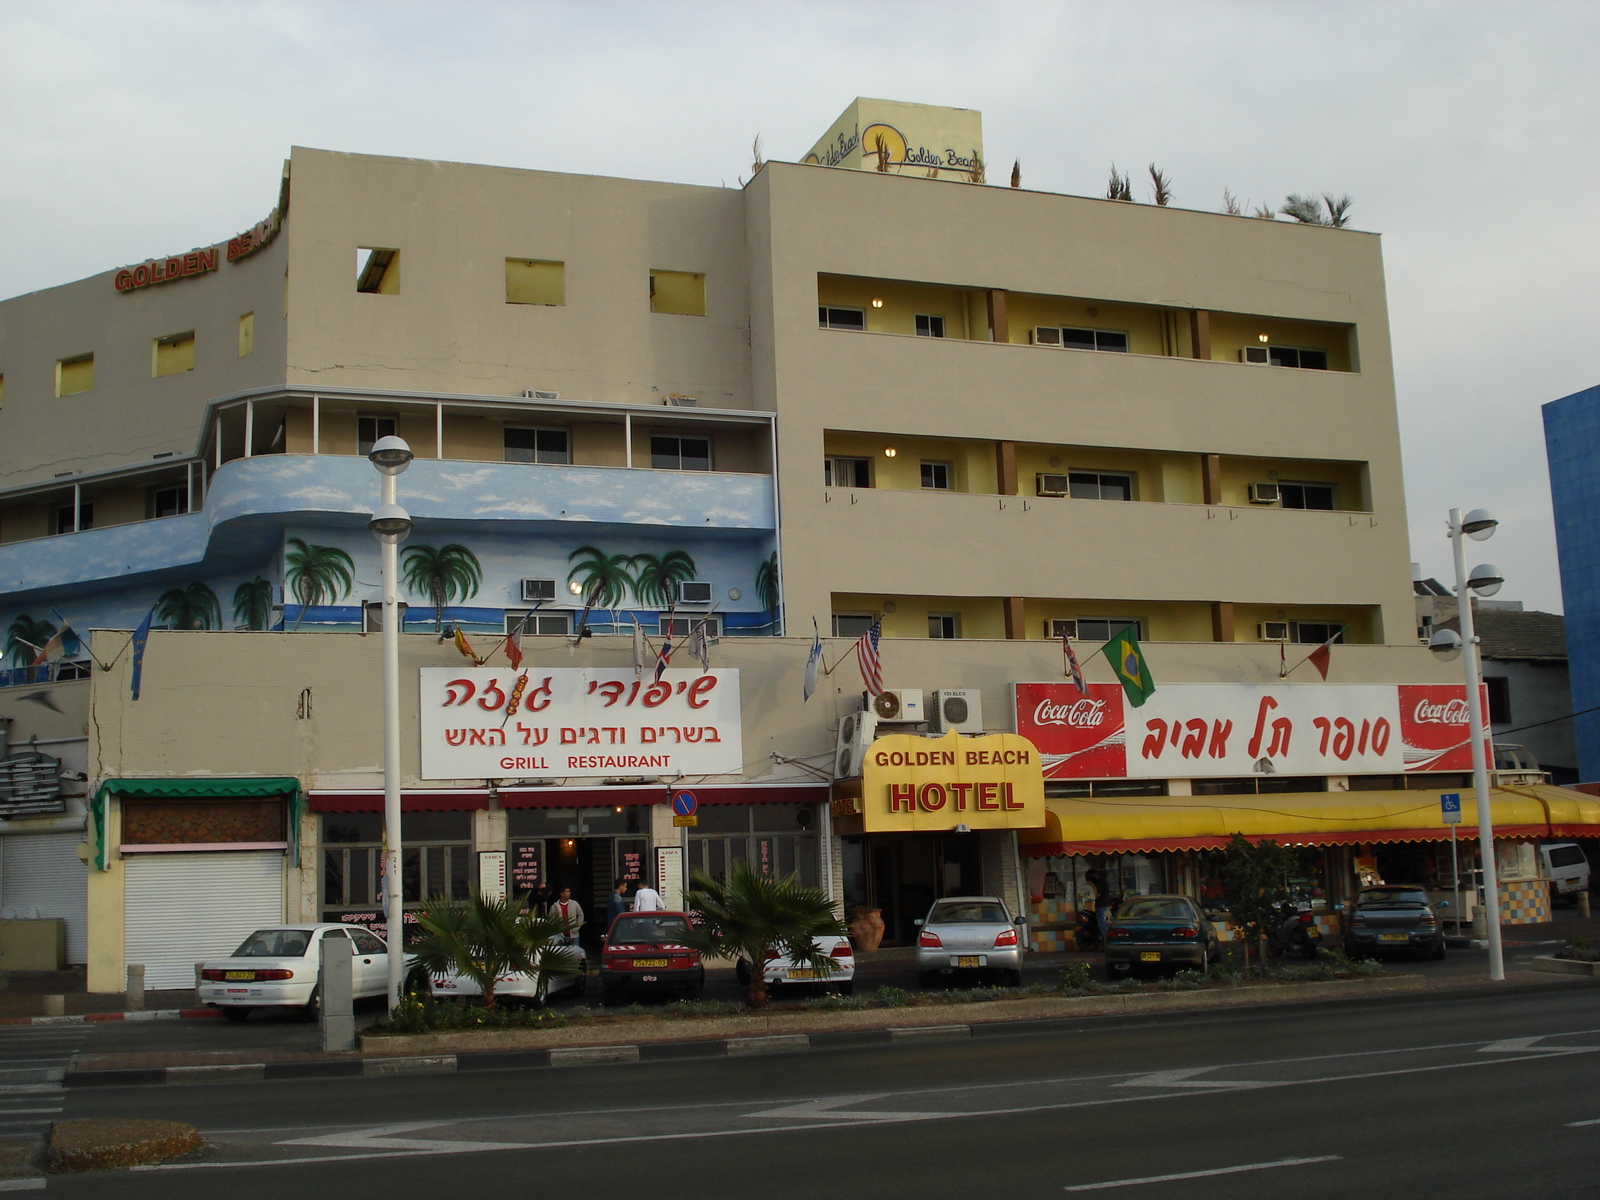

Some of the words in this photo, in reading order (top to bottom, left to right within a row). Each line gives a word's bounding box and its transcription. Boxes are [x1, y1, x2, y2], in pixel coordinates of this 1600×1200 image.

[906, 146, 944, 166] Golden
[114, 248, 217, 292] GOLDEN
[587, 675, 718, 709] שיפודי
[1033, 698, 1107, 727] Coca-Cola
[444, 727, 507, 747] האש
[515, 721, 549, 747] על
[559, 726, 627, 745] ודגים
[640, 726, 722, 744] בשרים
[1141, 717, 1233, 760] אביב
[1247, 695, 1293, 759] תל
[1313, 716, 1391, 761] סופר
[499, 757, 549, 770] GRILL
[567, 755, 670, 769] RESTAURANT
[875, 751, 955, 767] GOLDEN
[966, 750, 1029, 765] BEACH
[830, 798, 857, 818] HOTEL
[889, 782, 1025, 813] HOTEL
